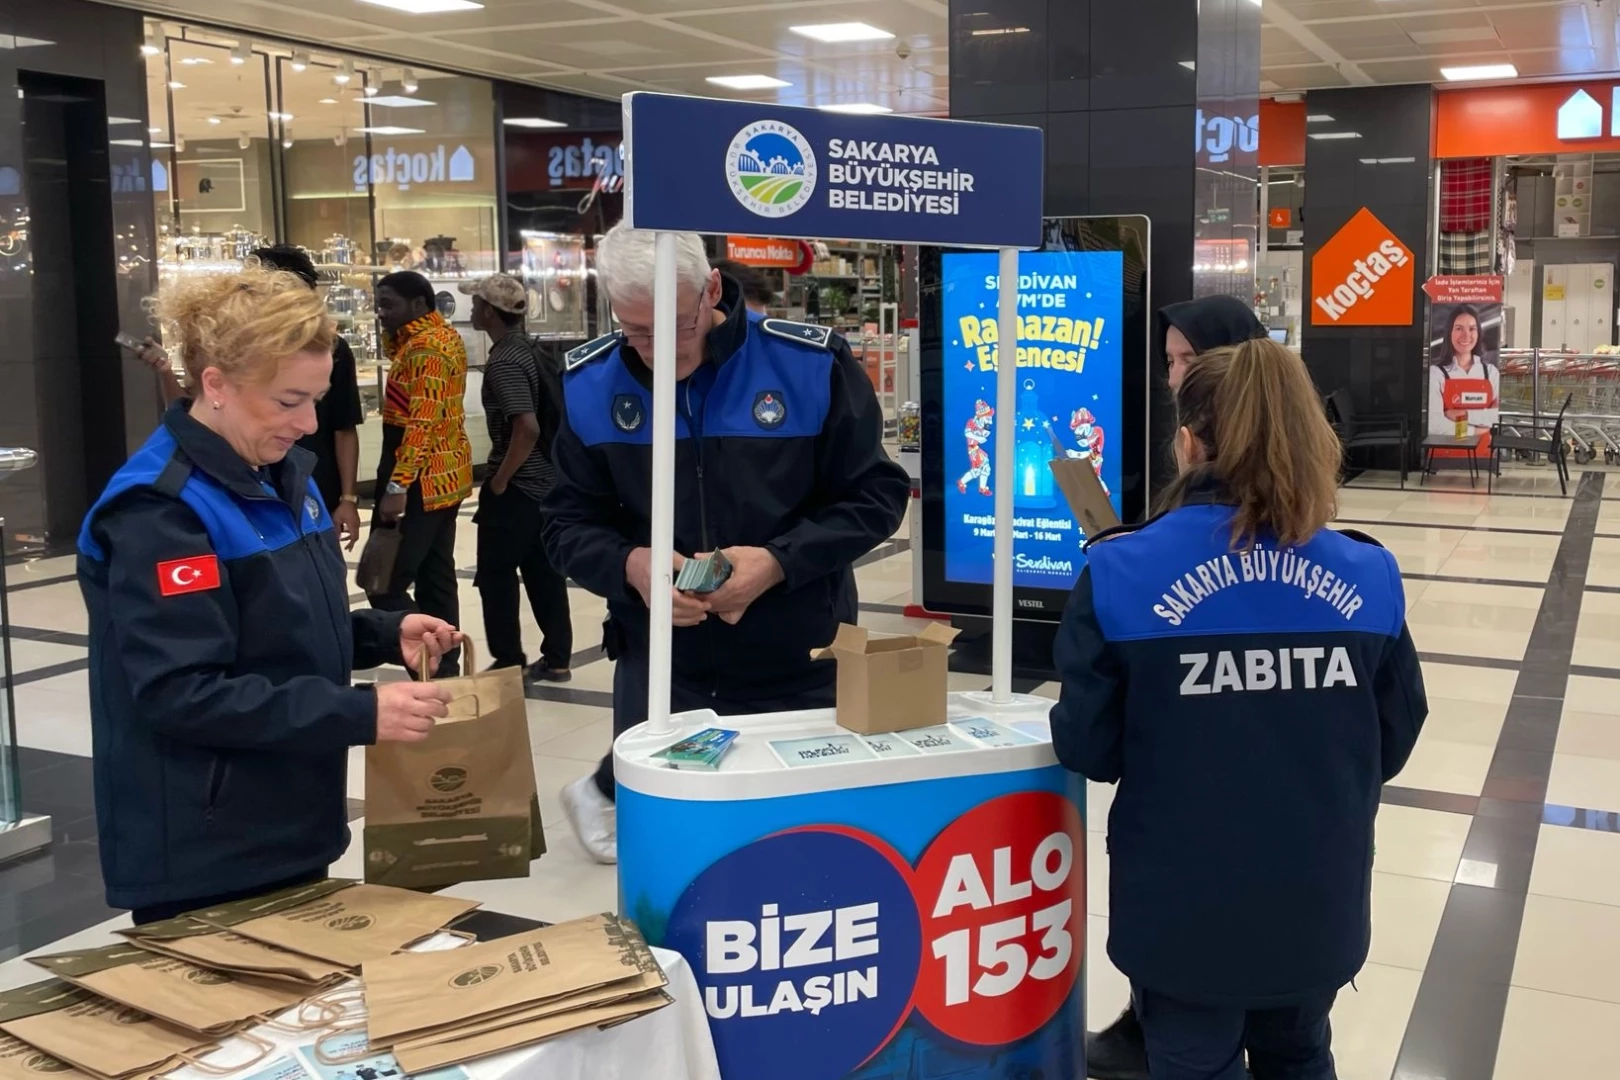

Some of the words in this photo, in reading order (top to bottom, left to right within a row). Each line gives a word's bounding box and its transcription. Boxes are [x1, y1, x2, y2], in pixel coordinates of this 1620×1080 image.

[829, 139, 939, 165] SAKARYA
[829, 160, 974, 192] BÜYÜKŞEHİR
[829, 188, 959, 215] BELEDİYESİ
[985, 271, 1077, 290] SDİVAN
[1315, 239, 1409, 321] koçtaş
[973, 528, 979, 536] 9
[1034, 532, 1044, 541] 16
[1045, 532, 1062, 541] Mart
[1016, 553, 1072, 571] Serdivan
[1018, 599, 1044, 609] VESTEL
[1153, 555, 1239, 626] SAKARYA
[1240, 543, 1363, 620] BÜYÜKŞEHİR
[1179, 646, 1358, 695] ZABITA
[931, 832, 1073, 919] ALO
[706, 902, 879, 974] BİZE
[931, 897, 1073, 1007] 153
[705, 966, 878, 1020] ULAŞIN
